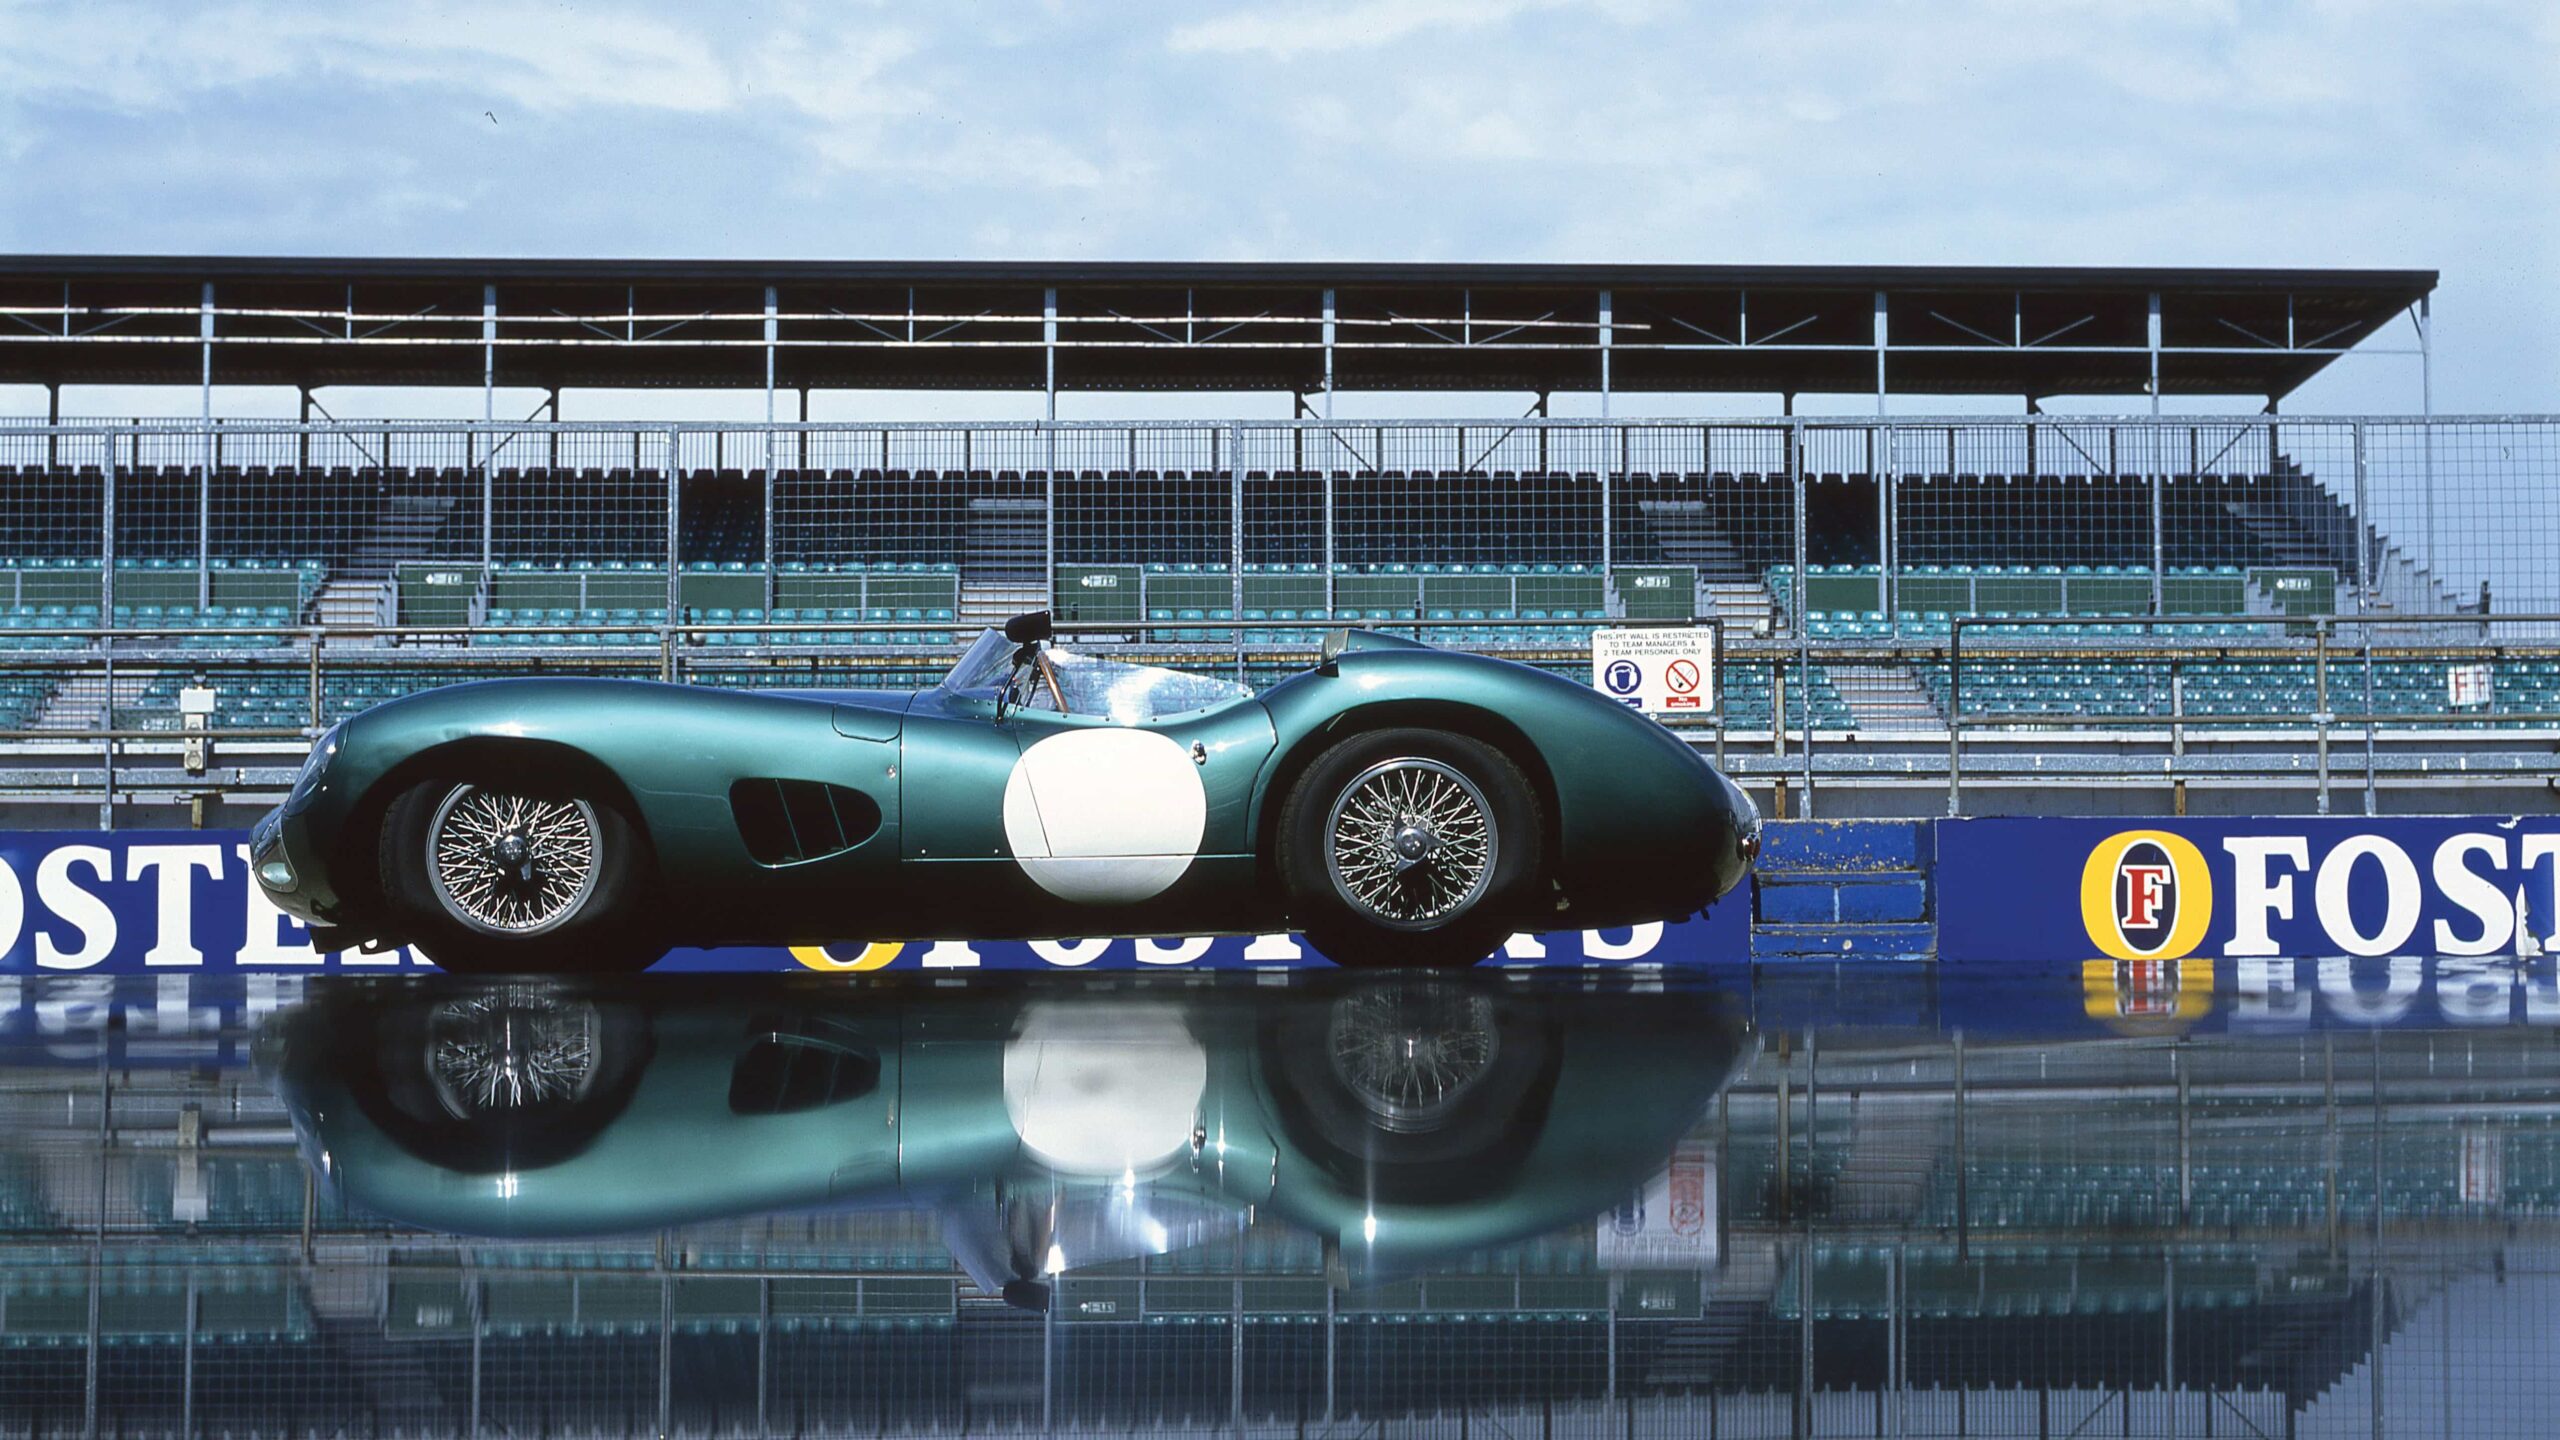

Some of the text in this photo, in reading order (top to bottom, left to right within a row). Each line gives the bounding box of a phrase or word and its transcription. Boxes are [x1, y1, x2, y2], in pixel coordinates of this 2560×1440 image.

[1662, 631, 1710, 639] RESTRICTED
[1634, 648, 1680, 656] PERSONNEL
[2121, 864, 2171, 929] F
